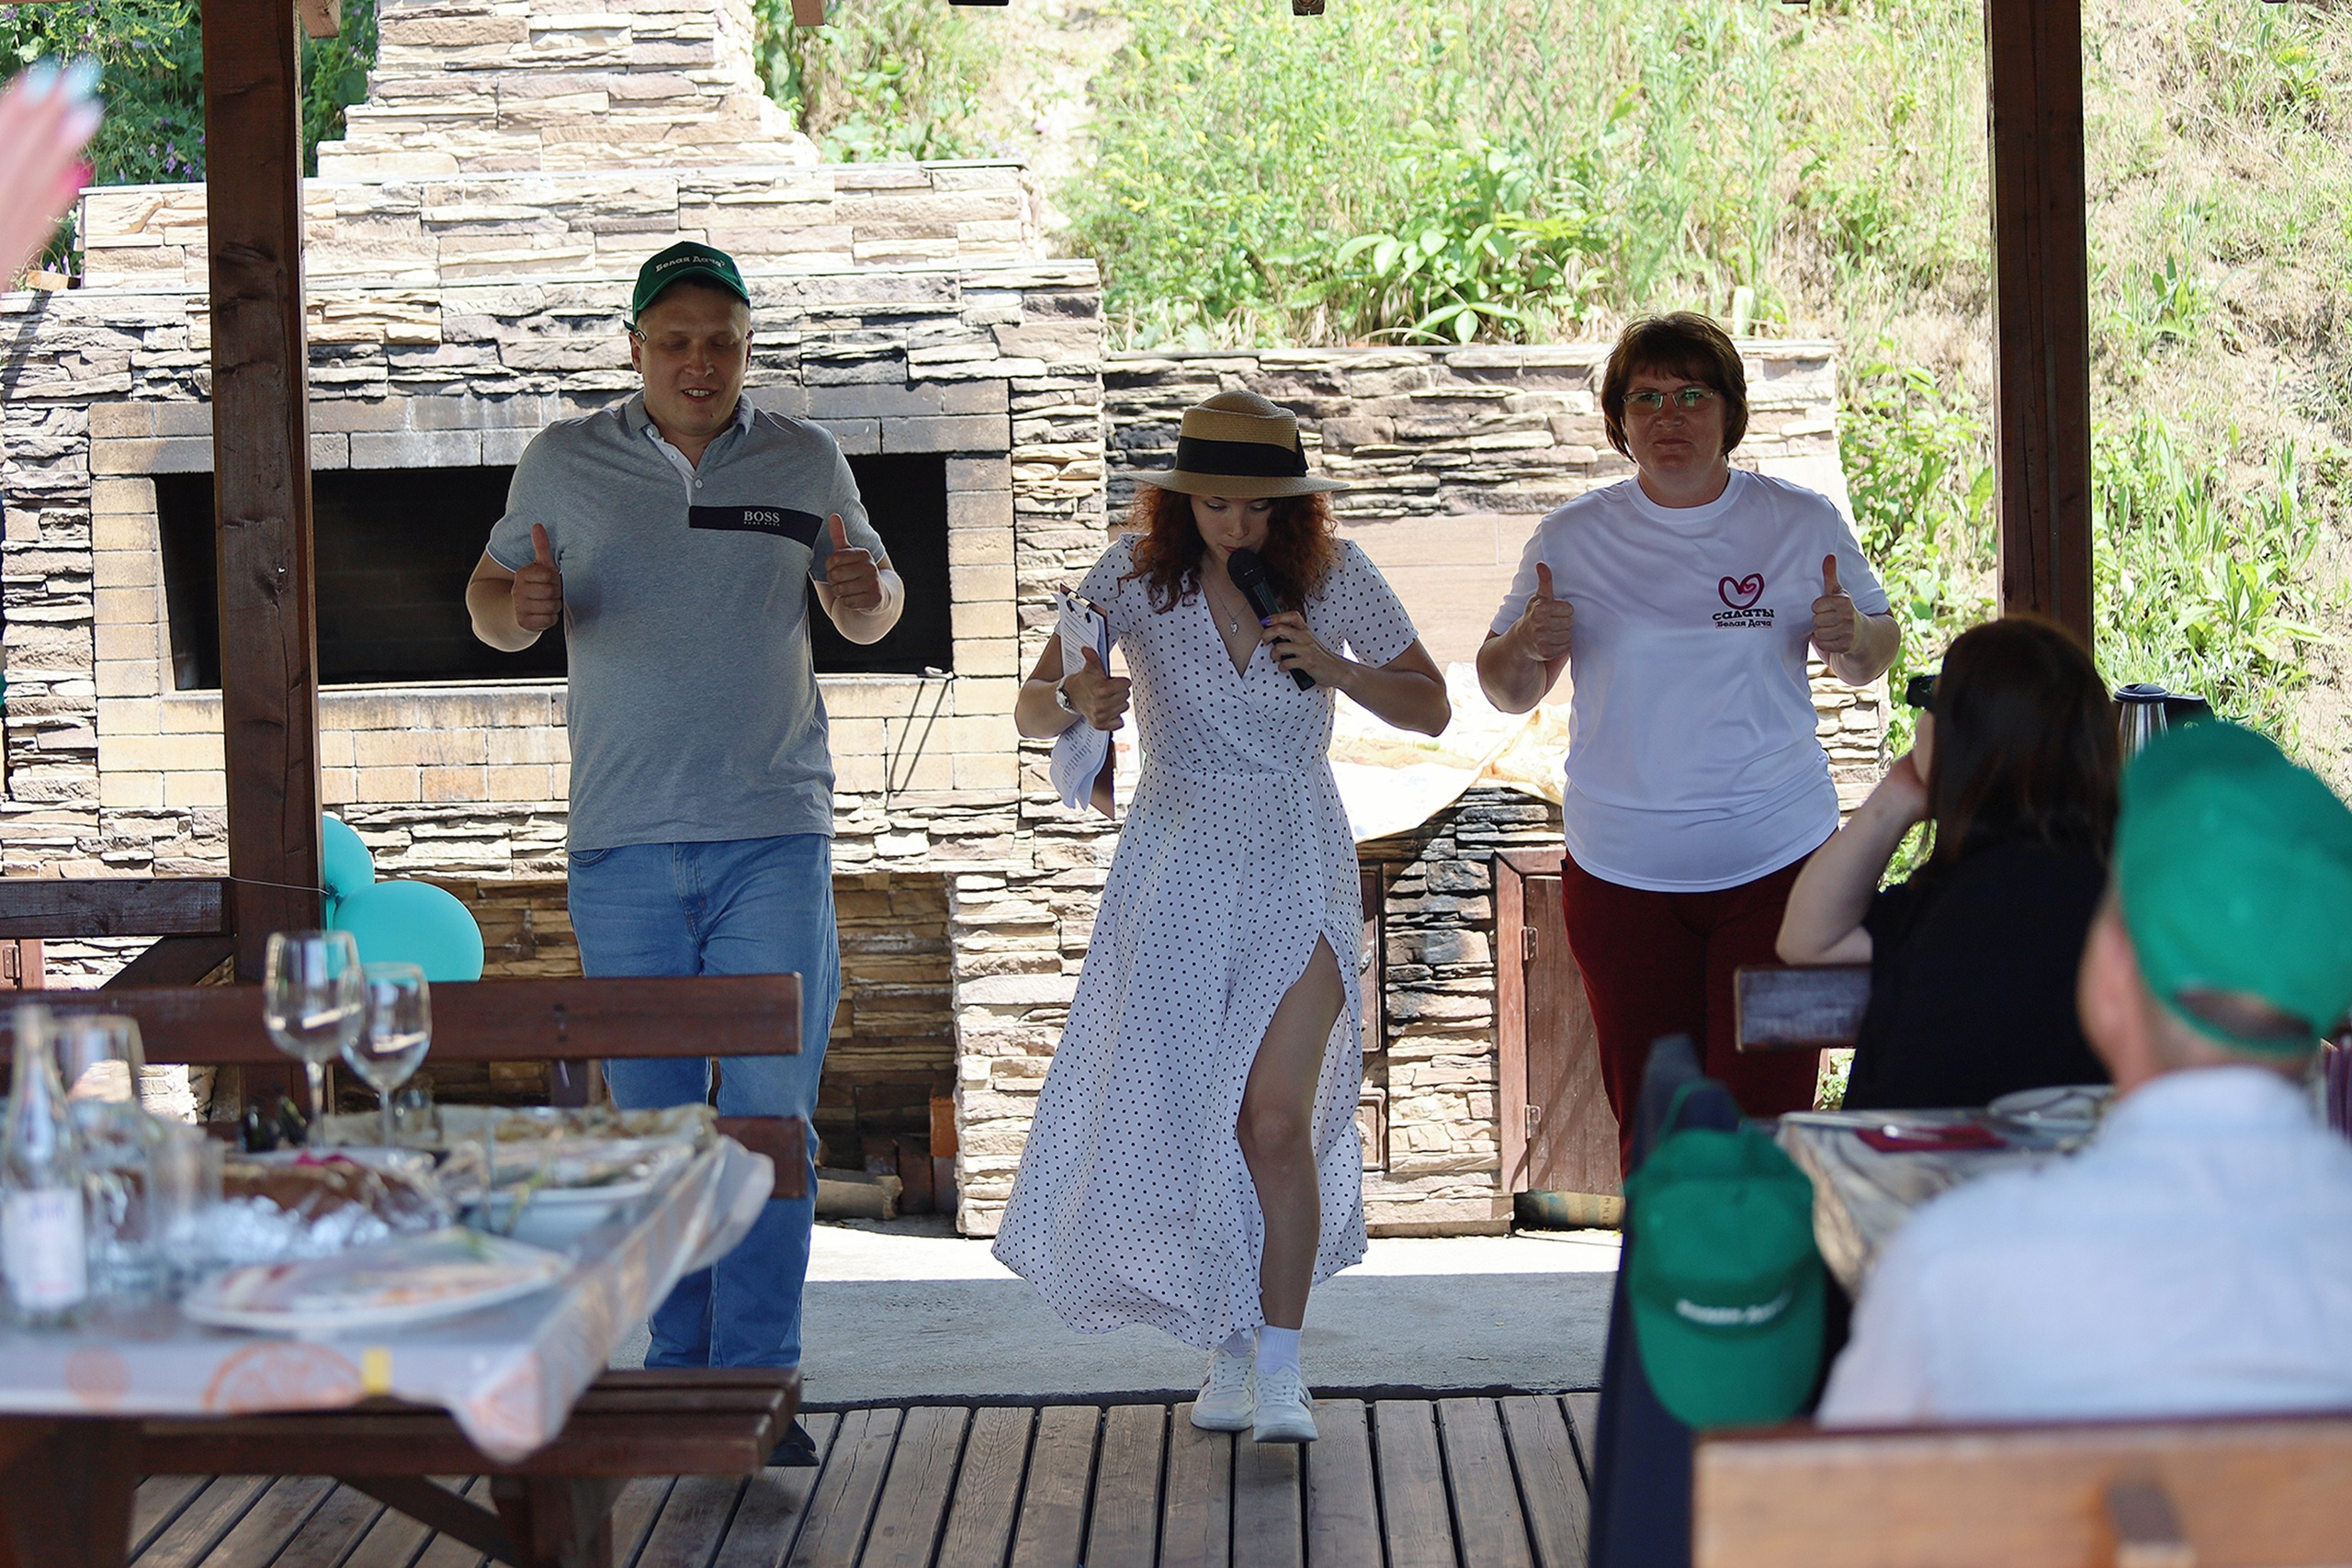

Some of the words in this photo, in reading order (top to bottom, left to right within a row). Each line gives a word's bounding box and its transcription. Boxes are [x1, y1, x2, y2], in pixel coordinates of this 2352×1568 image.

[655, 256, 691, 273] Белая
[693, 255, 723, 268] Дача
[743, 510, 781, 524] BOSS
[1747, 618, 1772, 628] Дача
